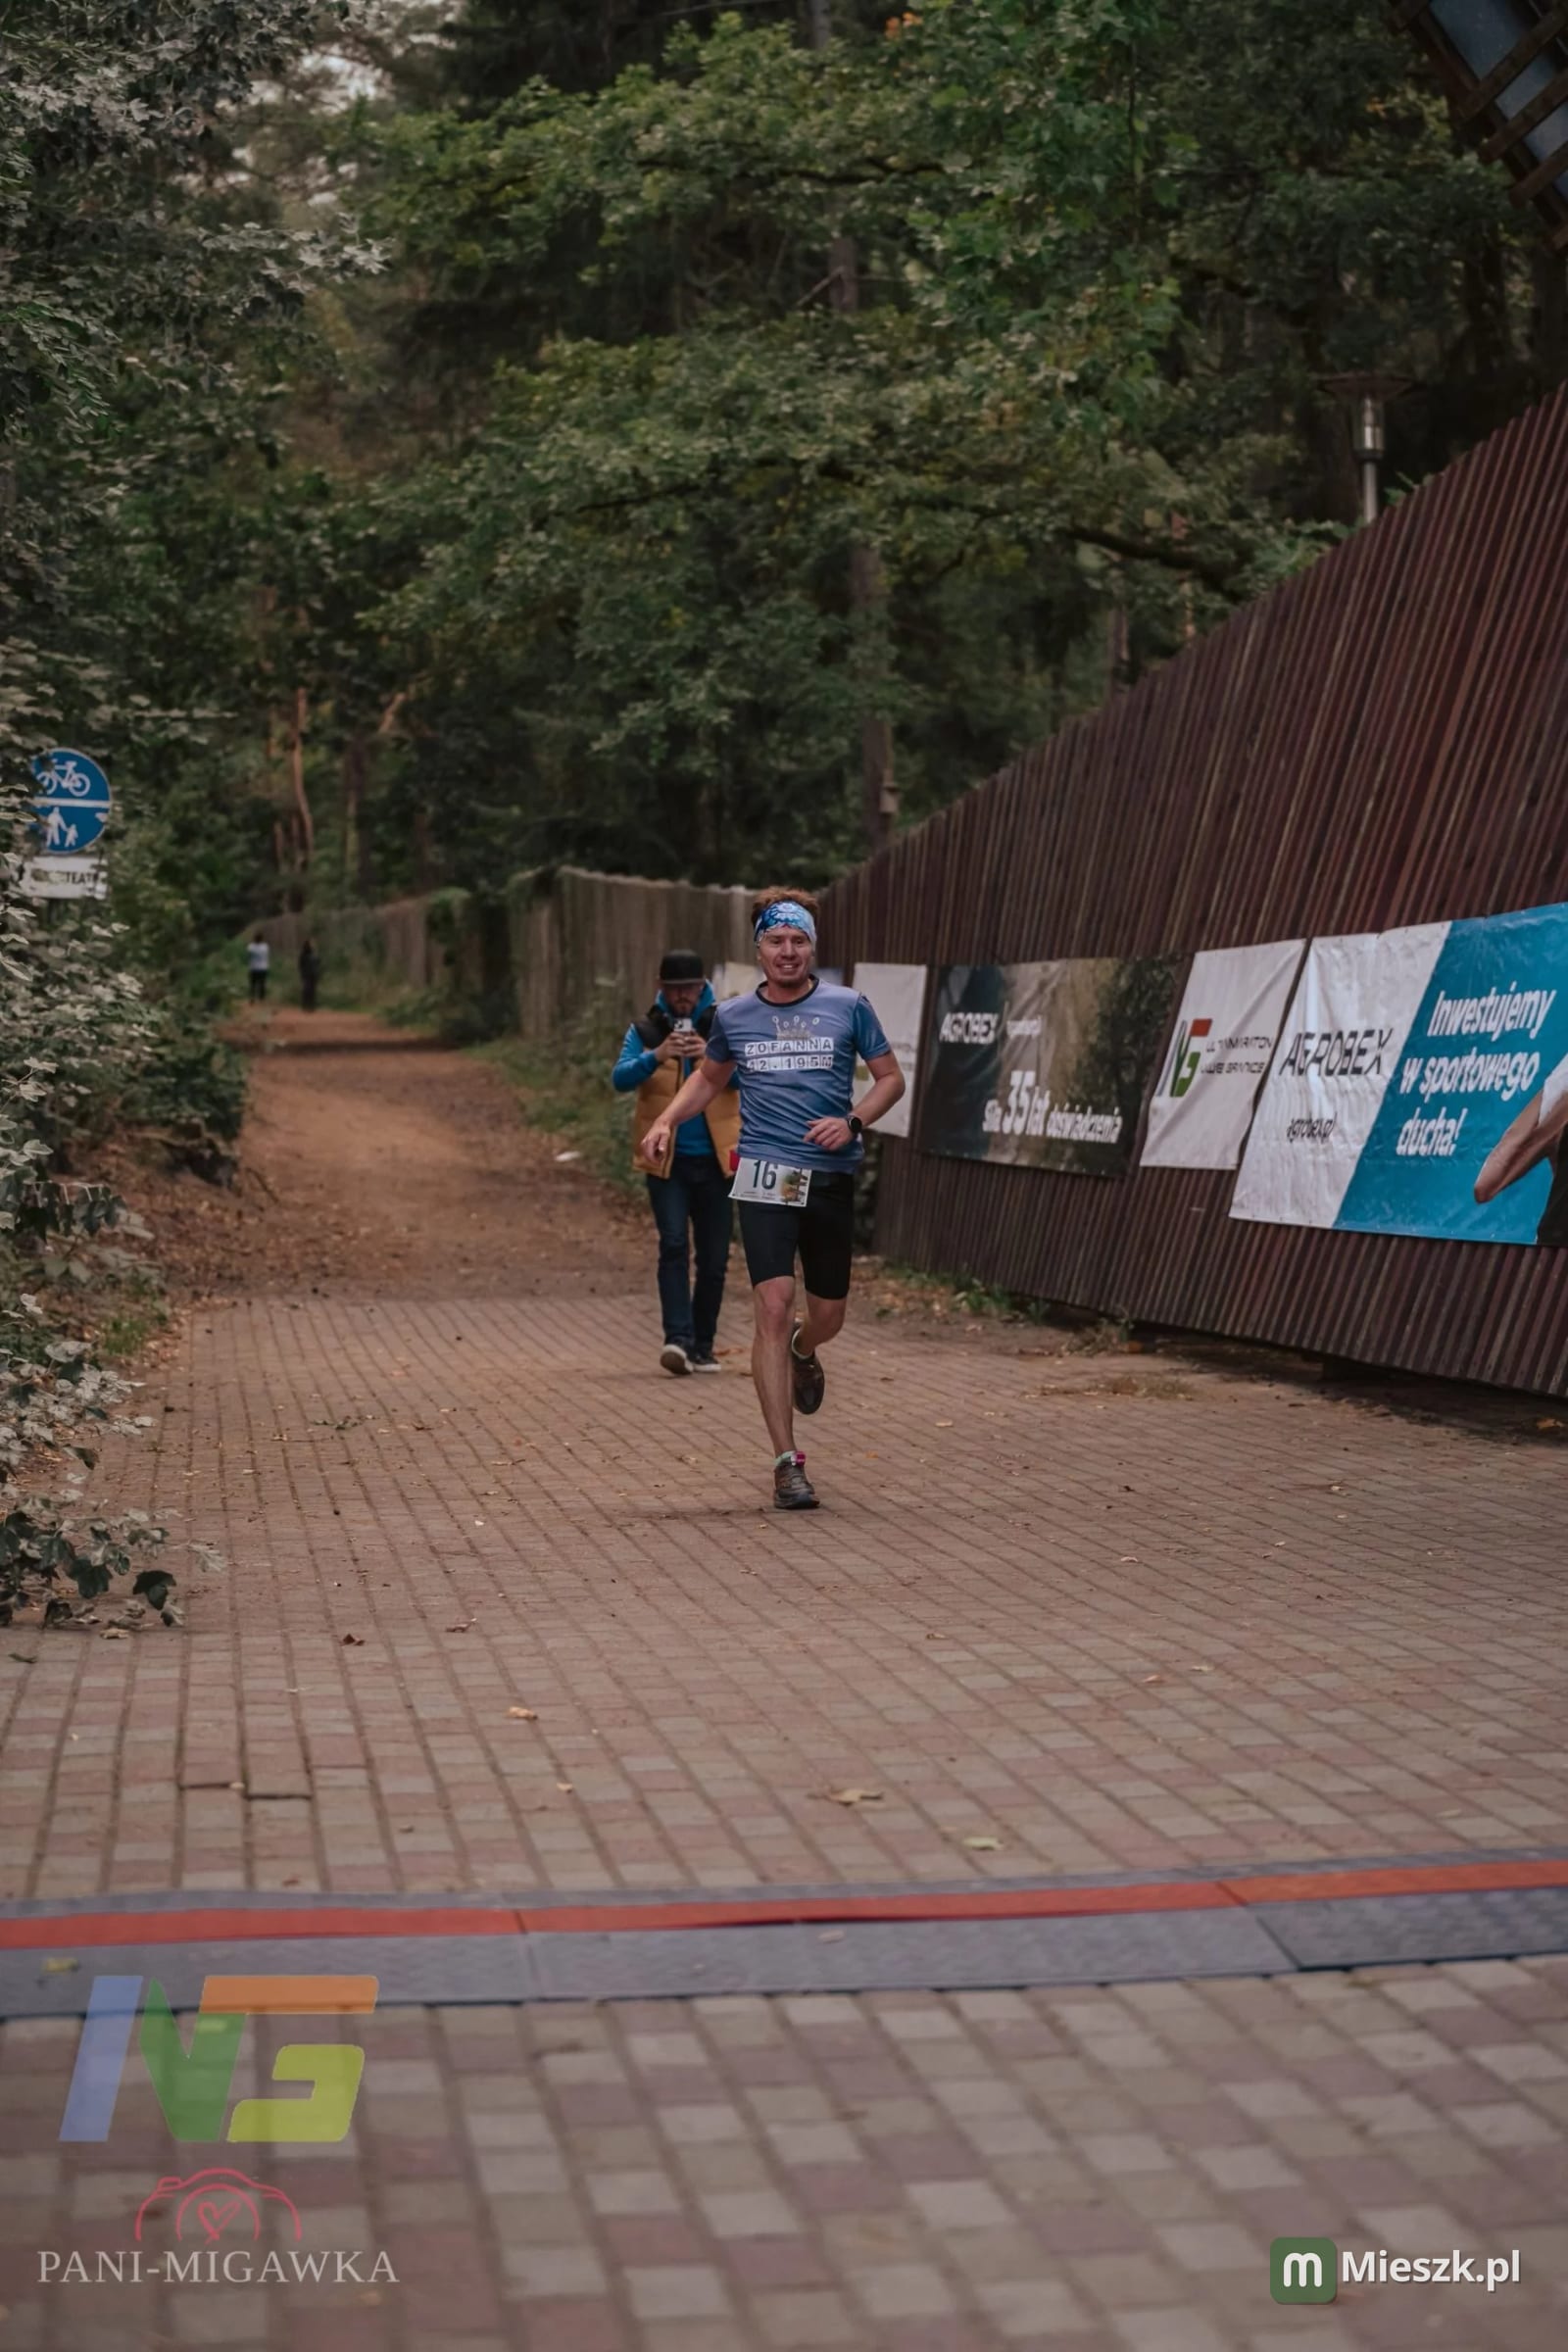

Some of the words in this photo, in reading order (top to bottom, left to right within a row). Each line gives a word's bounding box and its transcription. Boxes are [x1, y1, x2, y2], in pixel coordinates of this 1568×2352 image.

[939, 1011, 999, 1045] AGROBEX
[1427, 980, 1558, 1042] Inwestujemy
[747, 1039, 832, 1055] ZOFANNA
[1279, 1027, 1394, 1076] AGROBEX
[1399, 1057, 1424, 1095] w
[1419, 1046, 1541, 1102] sportowego
[1002, 1070, 1036, 1135] 35
[1396, 1106, 1468, 1156] ducha!
[752, 1159, 778, 1191] 16
